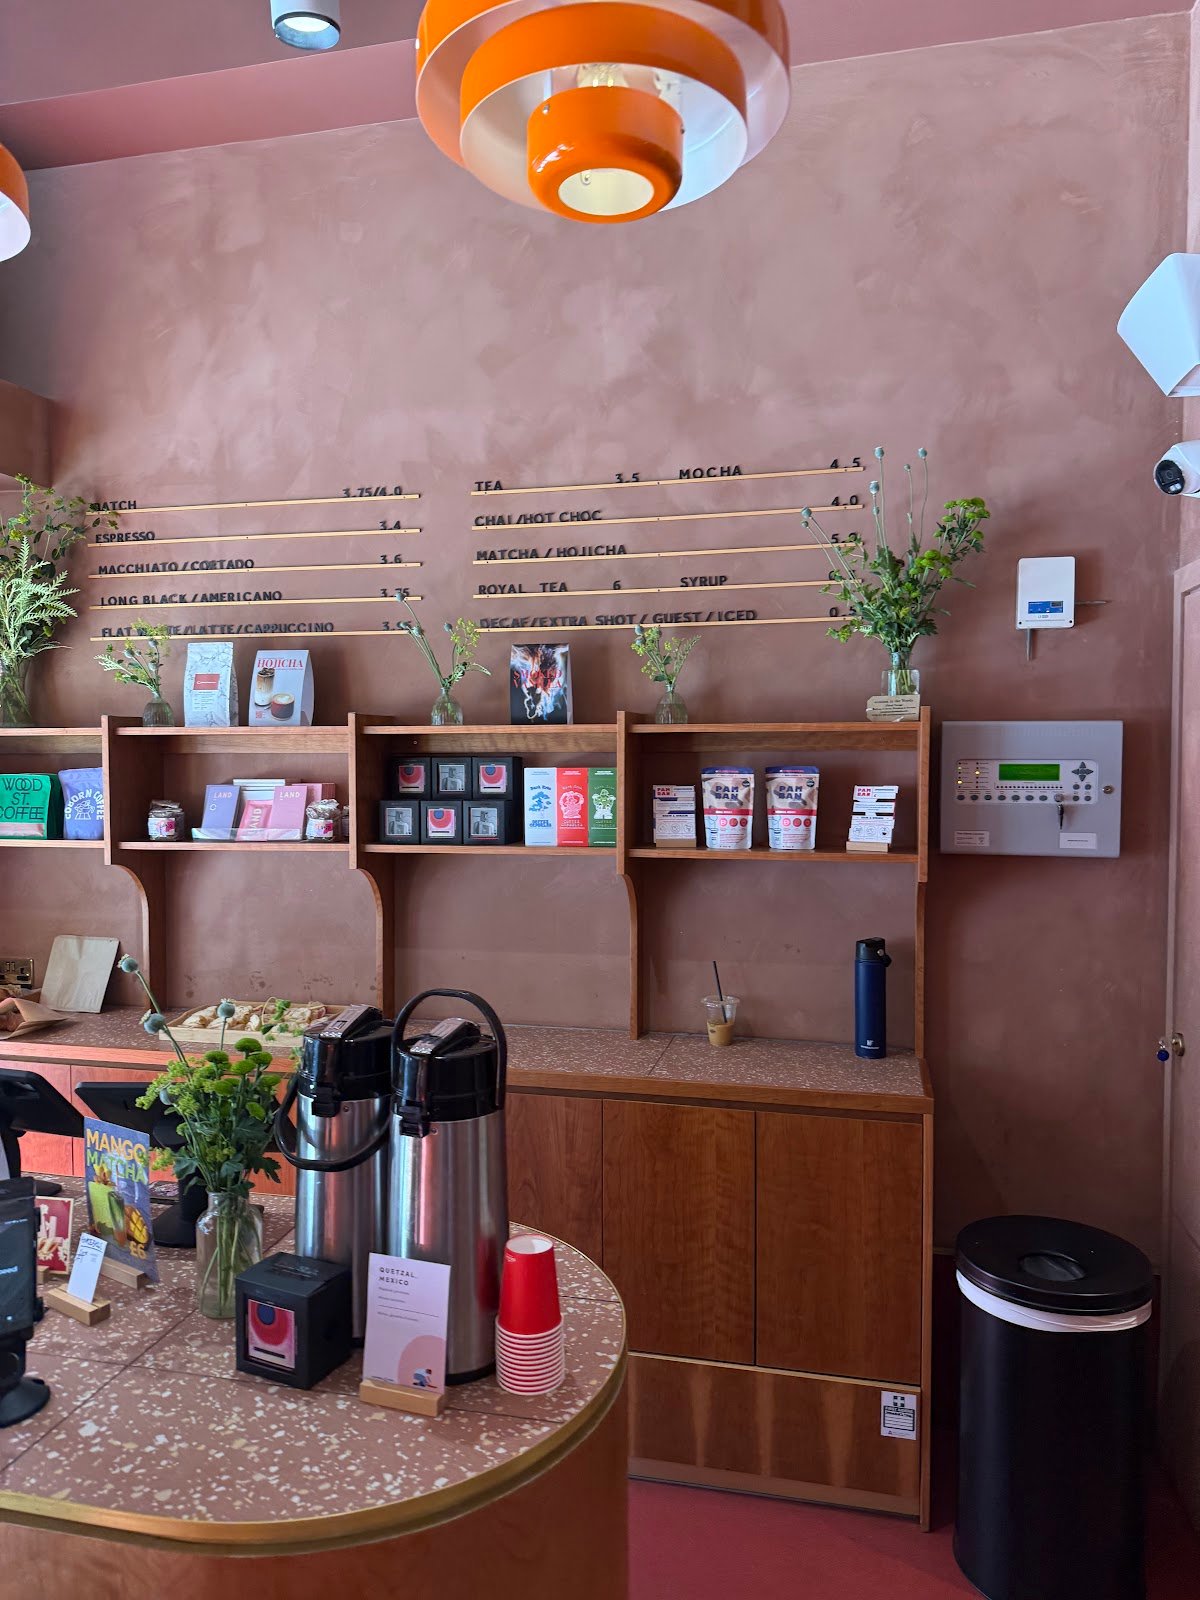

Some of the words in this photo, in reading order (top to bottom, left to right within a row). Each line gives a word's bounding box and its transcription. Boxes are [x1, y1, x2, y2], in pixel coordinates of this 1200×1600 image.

[475, 480, 503, 491] TEA
[615, 472, 639, 483] 3.5
[679, 465, 742, 479] MOCHA
[830, 457, 860, 468] 4.5
[342, 486, 402, 498] 3.75/4.0
[559, 510, 603, 522] CHOC
[831, 495, 858, 506] 4.0
[95, 531, 156, 543] ESPRESSO
[379, 520, 401, 531] 3.4
[557, 545, 627, 557] HOJICHA
[380, 554, 402, 564] 3.6
[478, 583, 527, 595] ROYAL
[539, 582, 568, 593] TEA
[612, 580, 621, 590] 6
[680, 575, 728, 587] SYRUP
[101, 595, 138, 606] LONG
[595, 614, 638, 625] SHOT
[653, 611, 702, 624] GUEST
[718, 609, 758, 621] ICED
[102, 627, 132, 637] FLAT
[257, 658, 304, 668] HOJICHA
[3, 777, 43, 791] WOOD
[715, 785, 739, 793] PAM
[213, 791, 232, 799] LAND
[279, 791, 300, 799] LAND
[86, 1128, 147, 1164] MANGO
[87, 1148, 149, 1185] MATCHA
[378, 1276, 409, 1287] MEXICO
